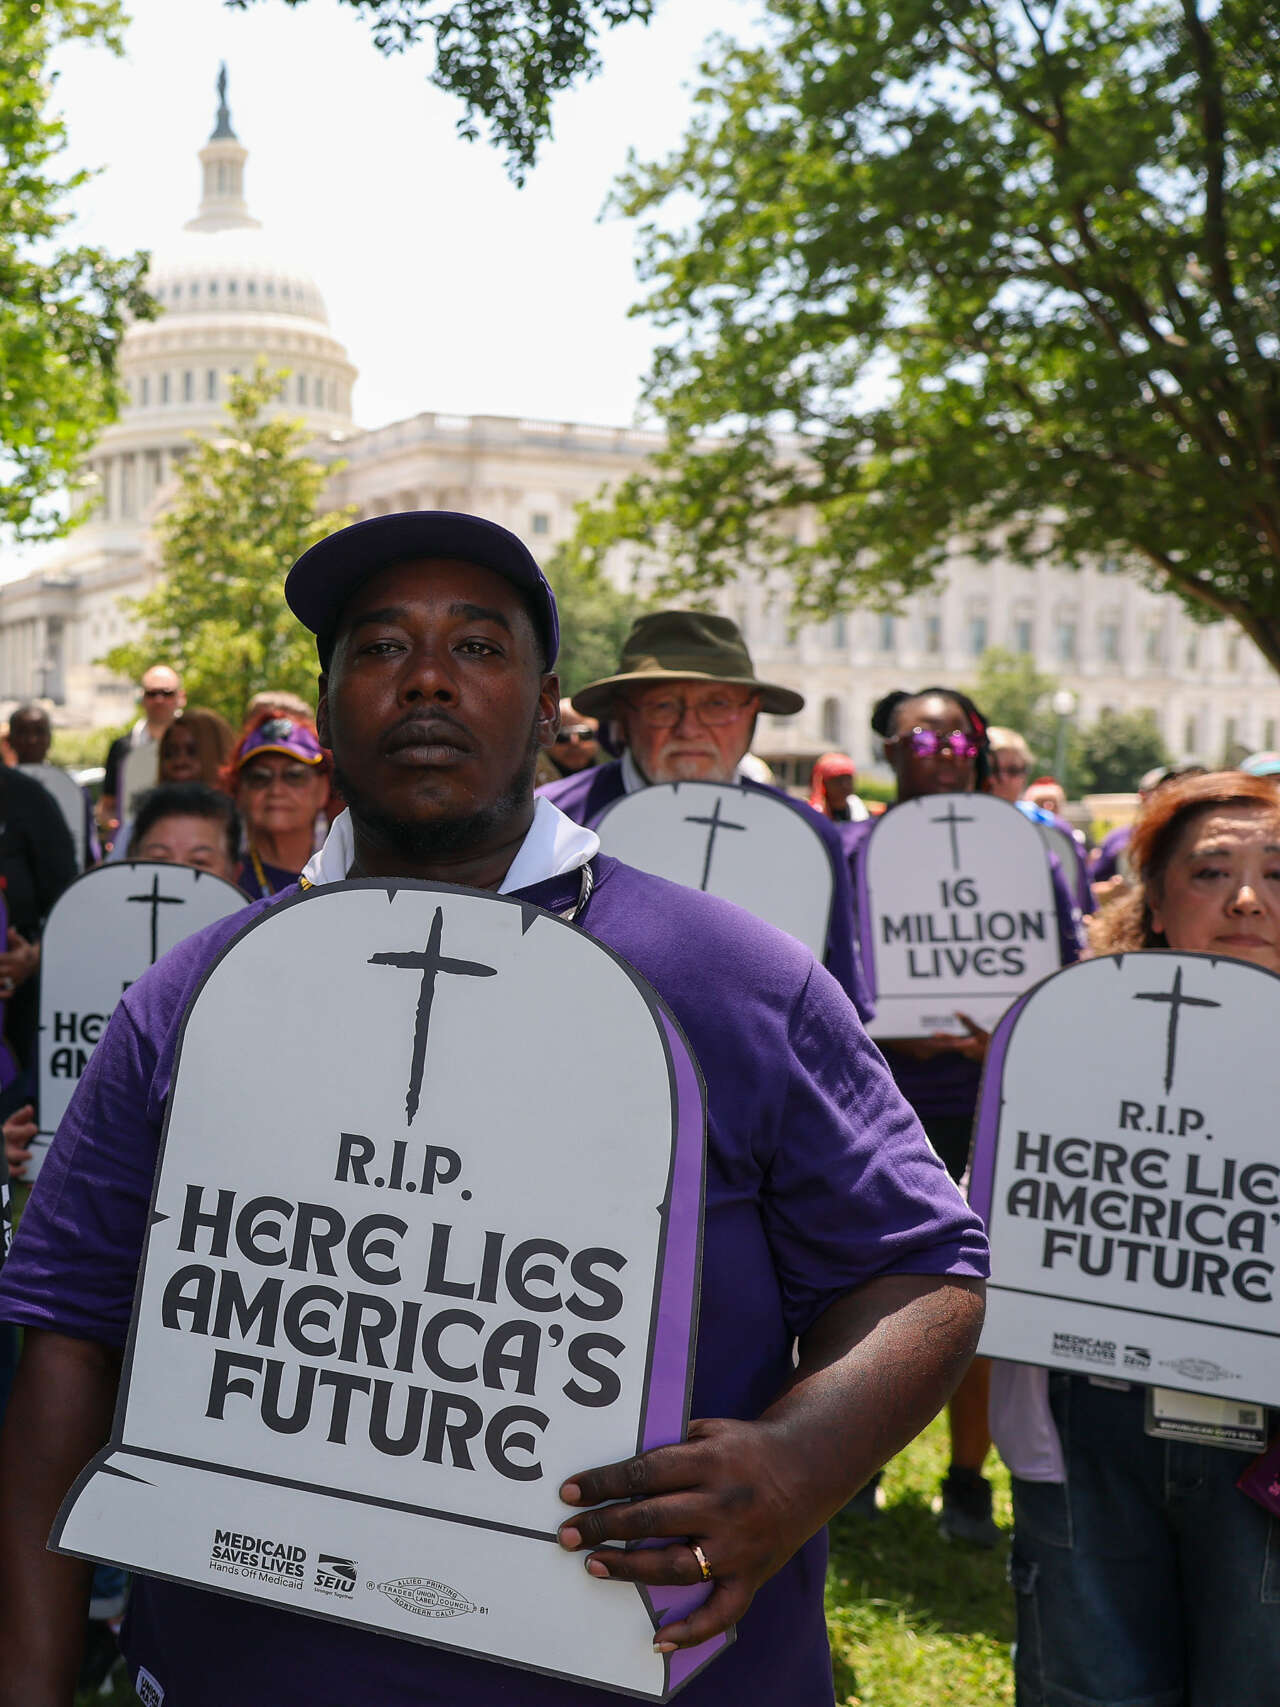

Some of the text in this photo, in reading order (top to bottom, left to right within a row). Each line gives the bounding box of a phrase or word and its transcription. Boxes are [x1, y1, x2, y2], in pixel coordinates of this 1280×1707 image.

[940, 878, 979, 908] 16
[882, 911, 1046, 944] MILLION
[907, 947, 1025, 979] LIVES
[54, 1011, 112, 1044] HE
[1119, 1100, 1213, 1141] R.I.P.
[334, 1132, 472, 1201] R.I.P.
[1014, 1130, 1280, 1205] HERE LIE
[1007, 1178, 1280, 1254] AMERICA'
[176, 1184, 628, 1322] HERE LIES
[1041, 1227, 1275, 1303] FUTURE
[162, 1264, 626, 1408] AMERICA'S
[205, 1349, 550, 1482] FUTURE
[212, 1545, 304, 1578] SAVES LIVES
[214, 1529, 307, 1563] MEDICAID
[209, 1561, 304, 1590] Hands Off Medicaid
[314, 1574, 355, 1592] SEIU
[383, 1585, 412, 1598] TRADES
[398, 1578, 458, 1600] ALLIED PRINTING
[394, 1597, 456, 1617] NORTHERN CALIF
[415, 1597, 435, 1605] LABEL
[416, 1590, 436, 1599] UNION
[439, 1598, 471, 1611] COUNCIL
[479, 1606, 489, 1615] 81
